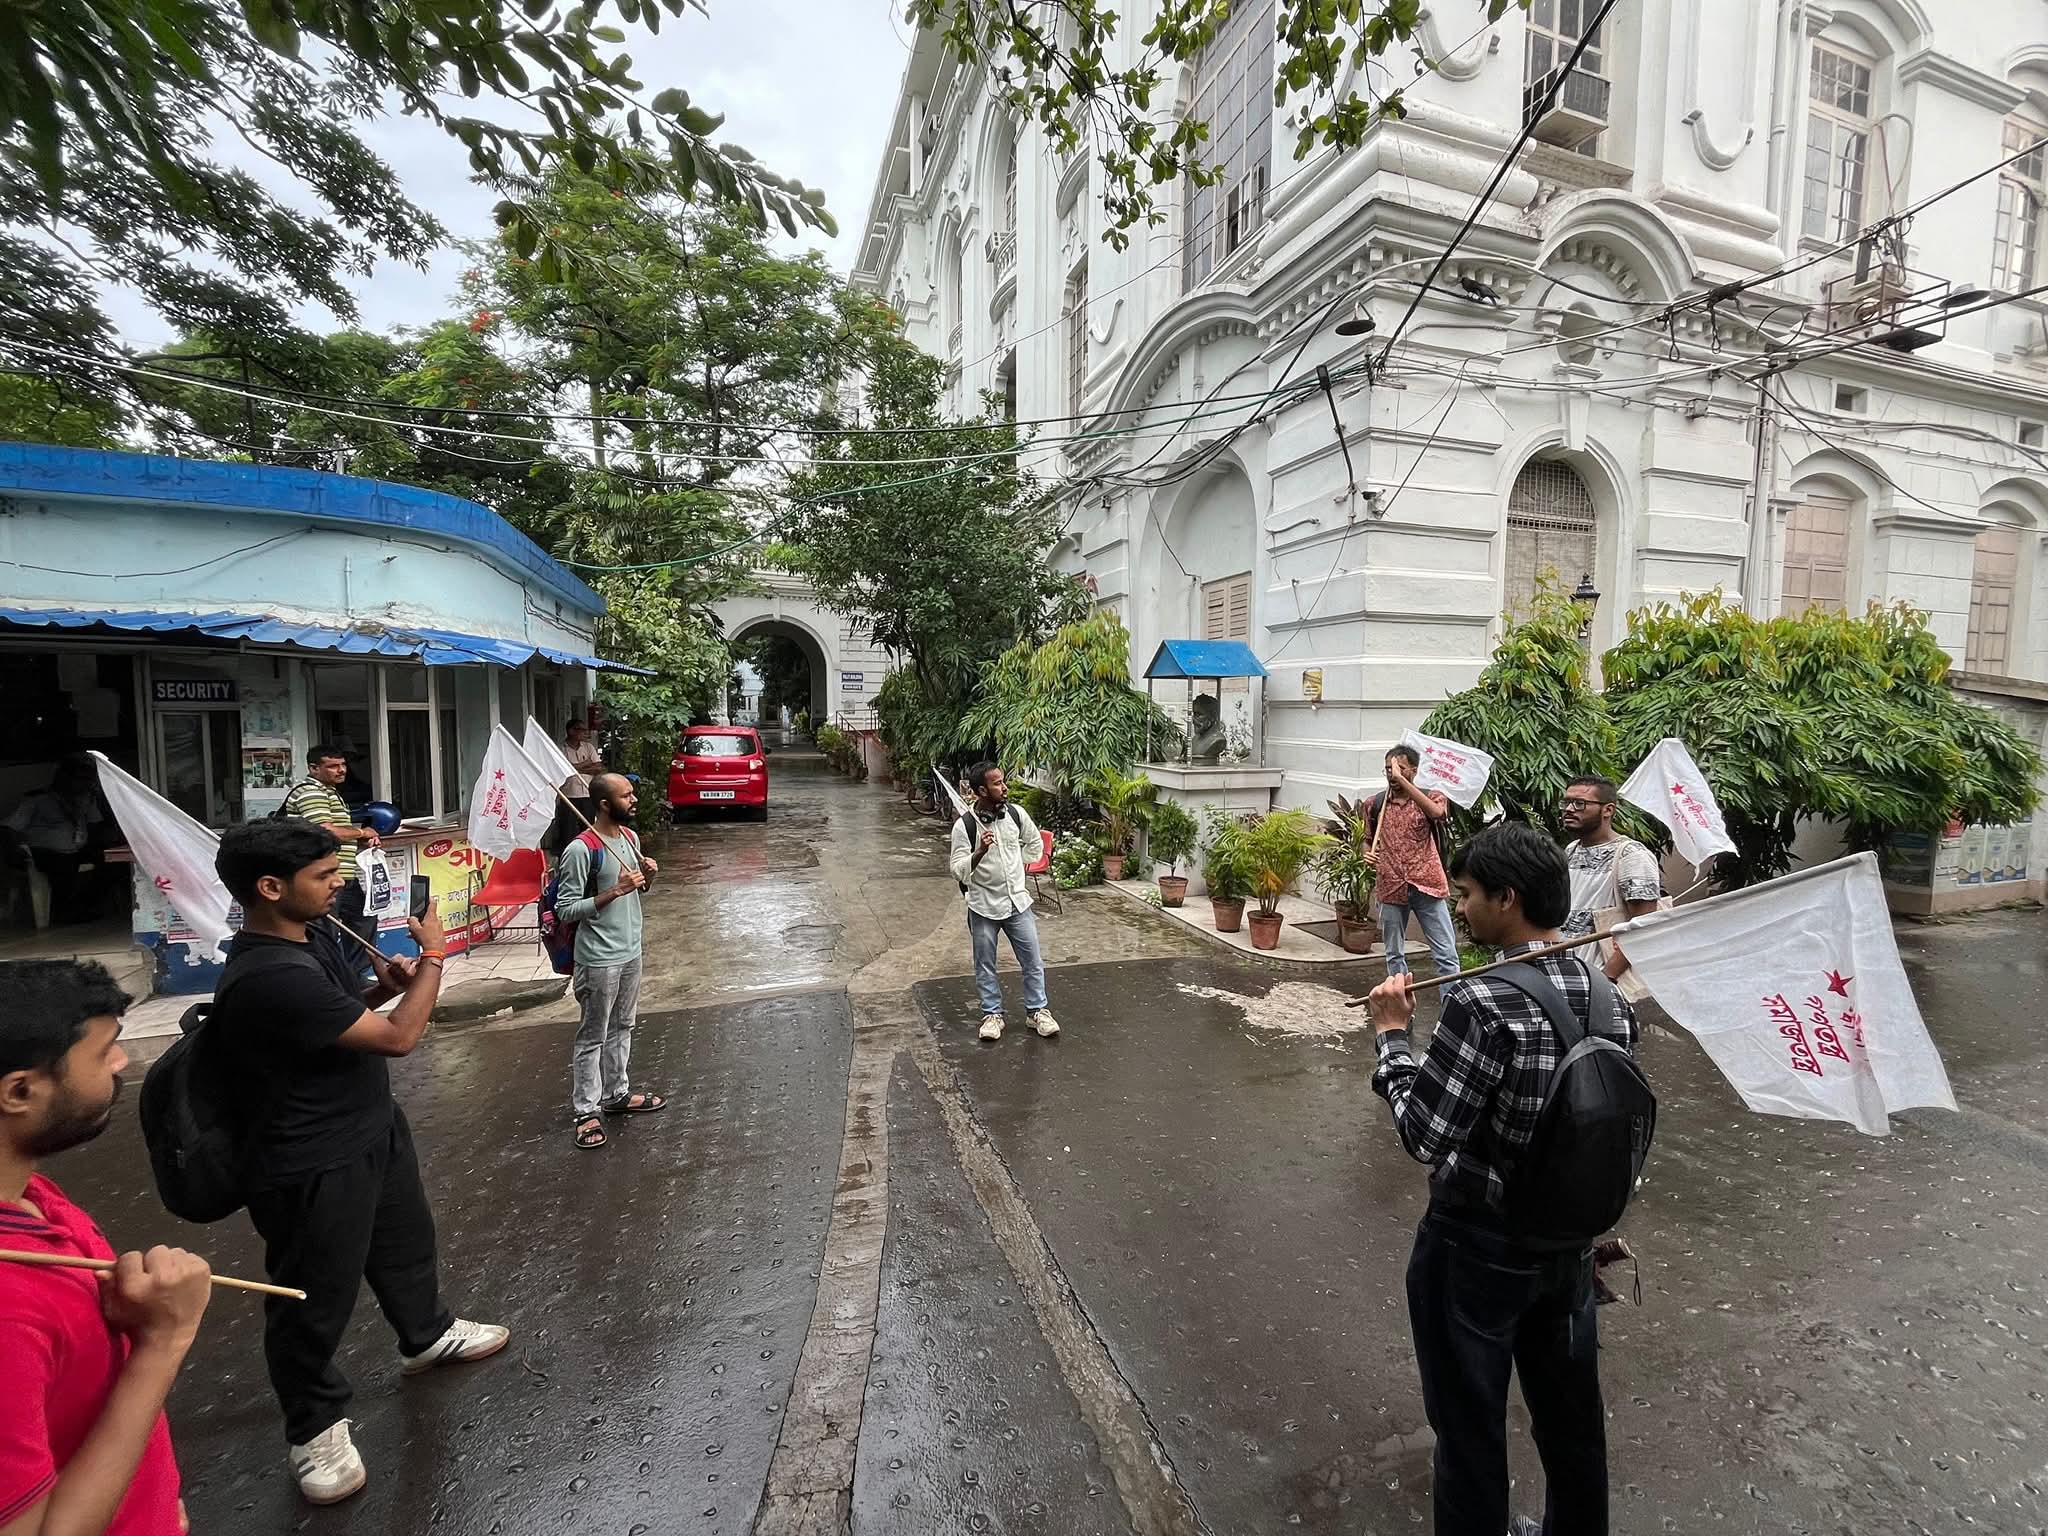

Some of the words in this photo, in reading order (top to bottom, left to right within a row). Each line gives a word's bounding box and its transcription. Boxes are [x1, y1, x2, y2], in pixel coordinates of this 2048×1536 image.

[157, 682, 231, 699] SECURITY
[1760, 993, 1823, 1076] সমাজতন্ত্র
[1802, 995, 1850, 1063] গণতন্ত্র
